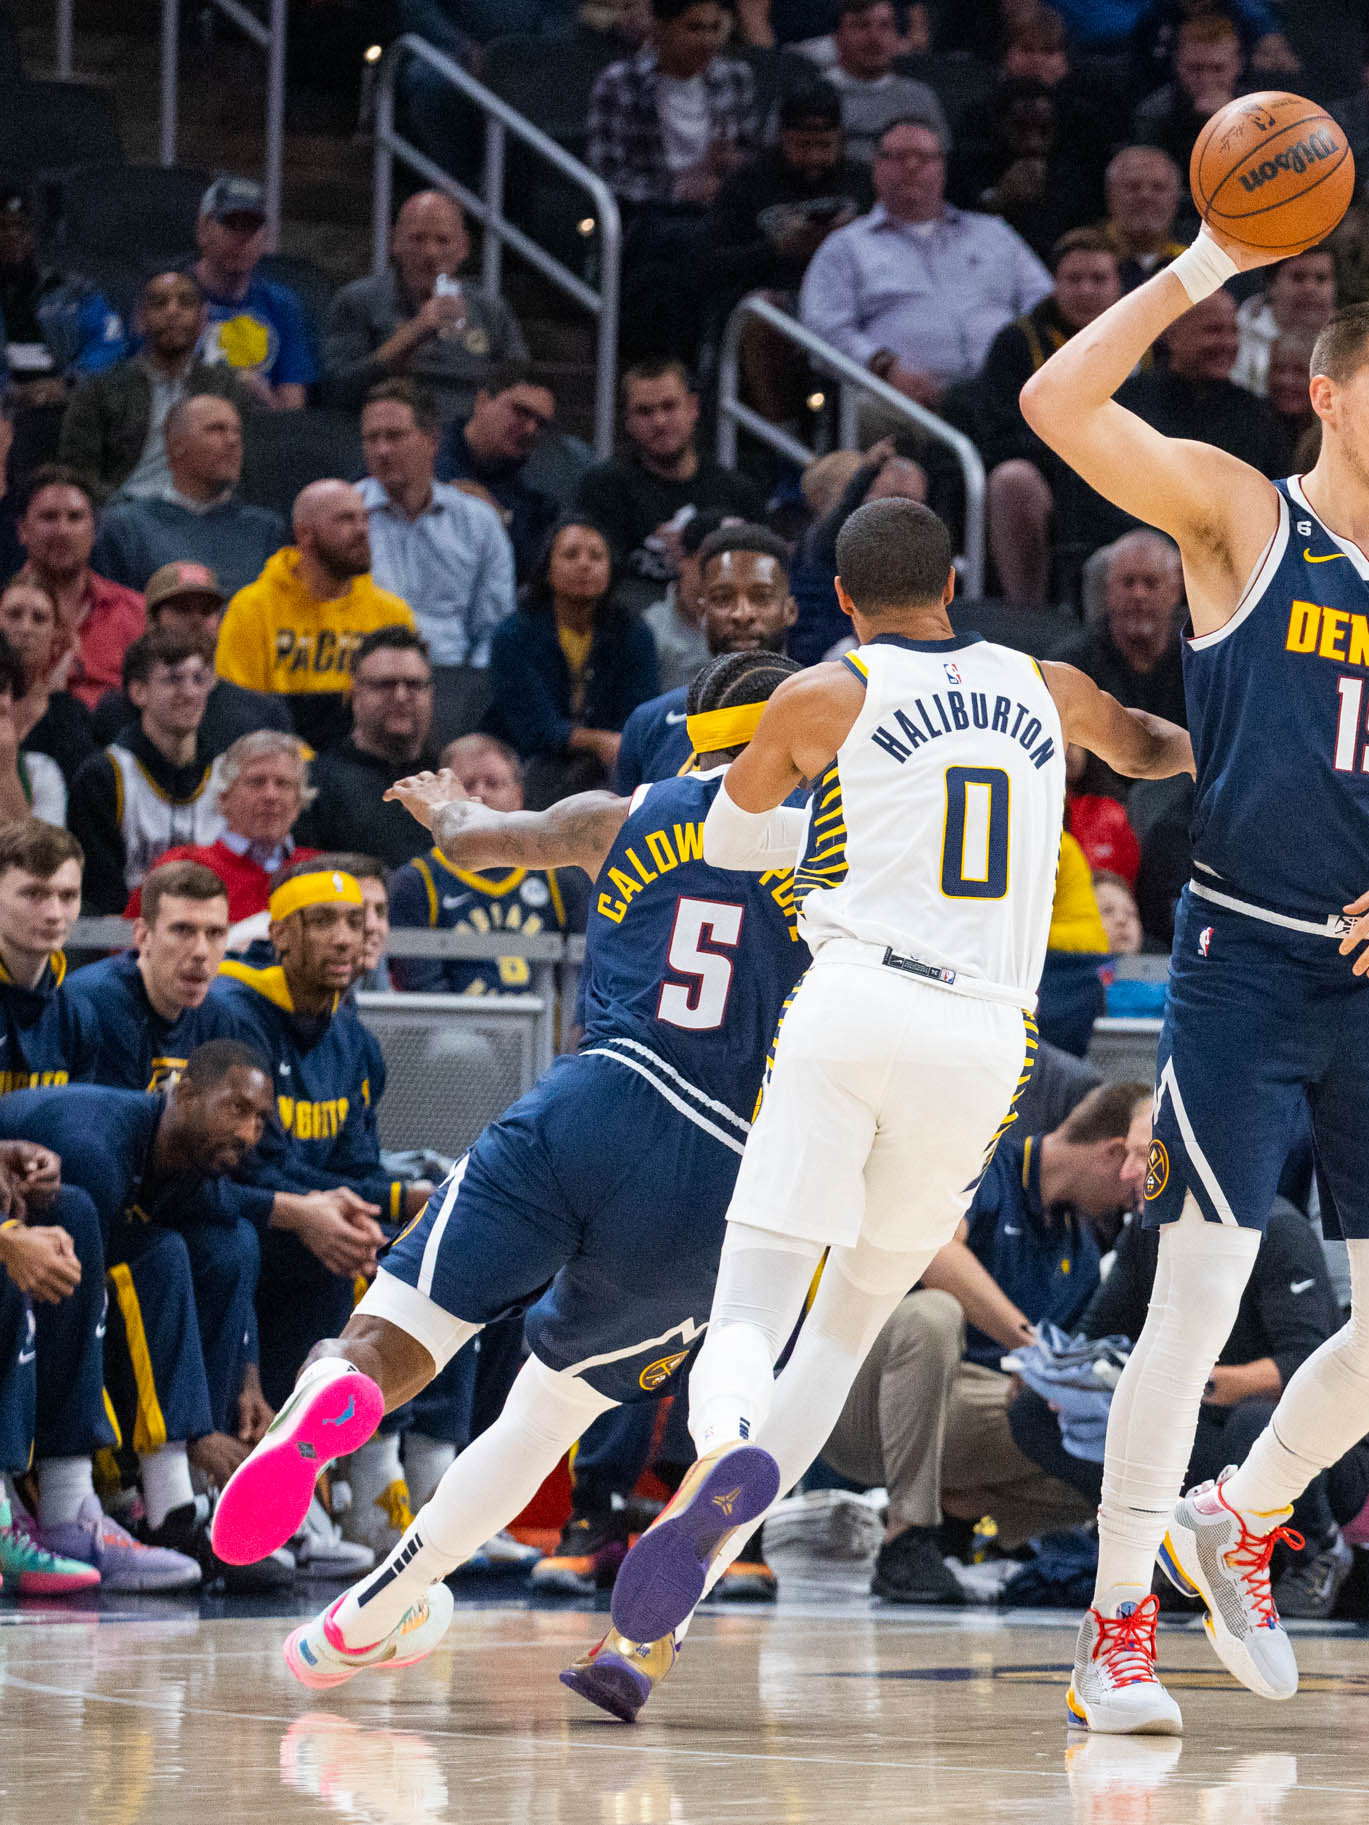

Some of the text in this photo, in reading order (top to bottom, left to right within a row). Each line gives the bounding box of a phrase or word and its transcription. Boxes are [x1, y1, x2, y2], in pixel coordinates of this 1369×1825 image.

[1238, 126, 1340, 193] Wilson
[1297, 520, 1312, 537] 6
[871, 690, 1056, 770] HALIBURTON
[939, 764, 1011, 900] 0
[656, 895, 745, 1032] 5
